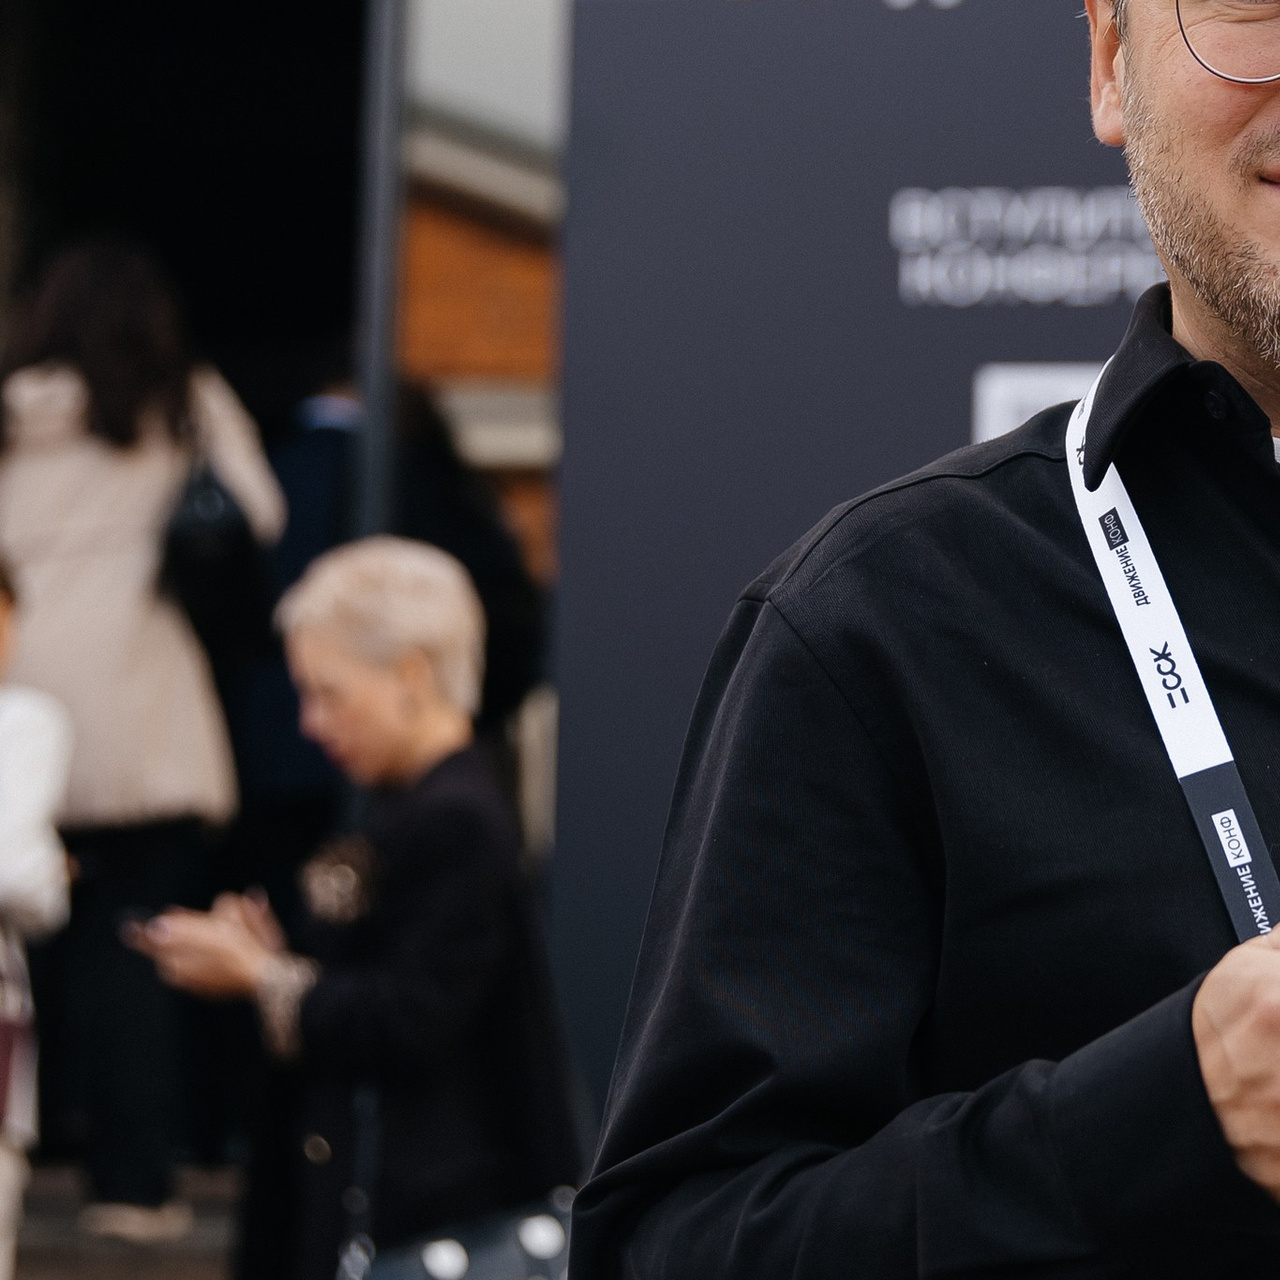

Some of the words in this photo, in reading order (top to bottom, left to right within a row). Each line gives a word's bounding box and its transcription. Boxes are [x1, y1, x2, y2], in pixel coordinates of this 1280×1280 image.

[1102, 511, 1126, 547] КОНФ
[1115, 545, 1151, 606] ДВИЖЕНИЕ
[1218, 814, 1247, 862] КОНФ
[1236, 865, 1272, 935] ИЖЕНИЕ
